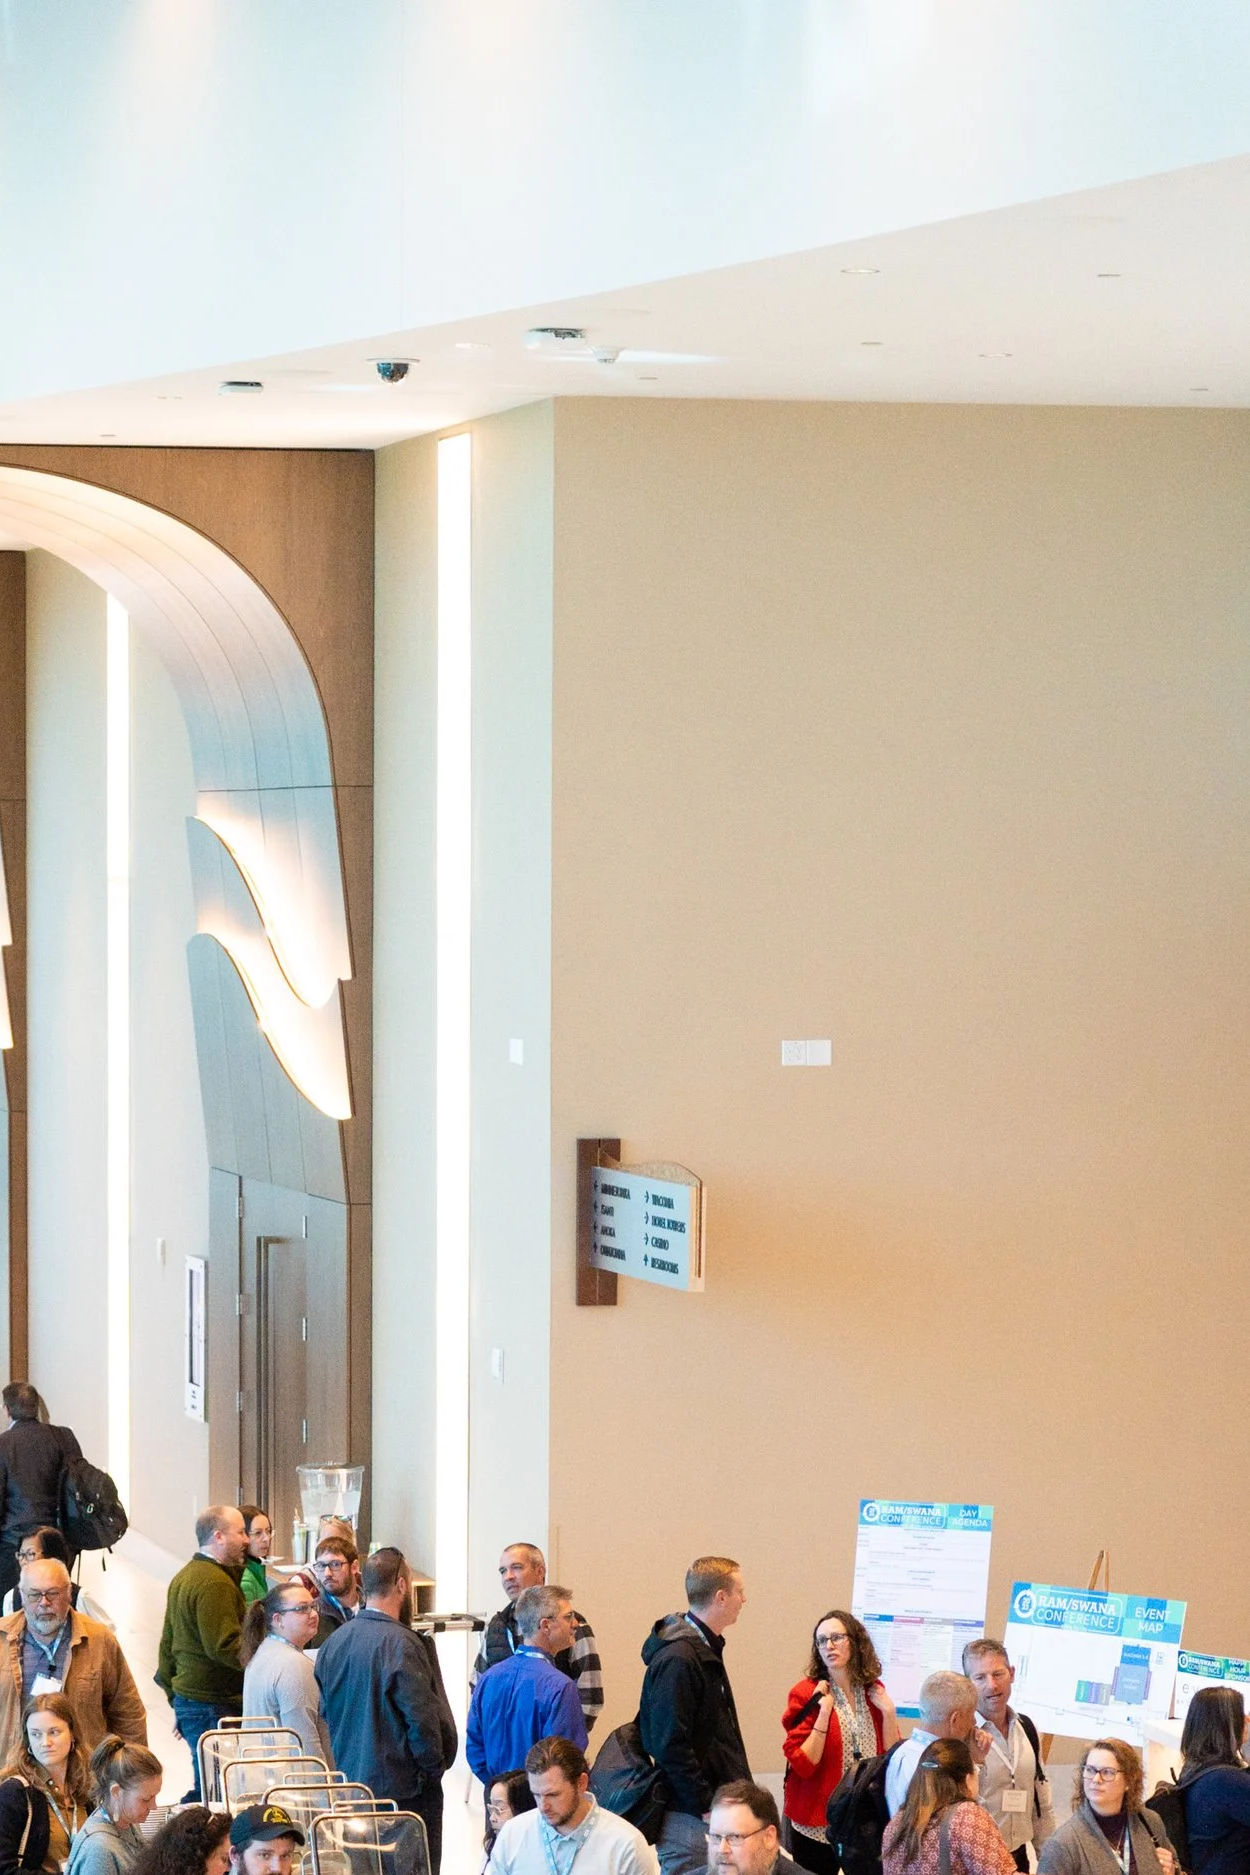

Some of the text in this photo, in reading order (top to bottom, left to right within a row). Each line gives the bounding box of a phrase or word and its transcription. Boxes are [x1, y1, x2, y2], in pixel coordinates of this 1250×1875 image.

[651, 1236, 669, 1251] CASINO
[881, 1505, 942, 1517] RAM/SWANA
[959, 1508, 977, 1518] DAY
[880, 1513, 942, 1526] CONFERENCE
[952, 1517, 988, 1528] AGENDA
[1038, 1595, 1117, 1616] RAM/SWANA
[1036, 1609, 1115, 1630] CONFERENCE
[1135, 1606, 1172, 1621] EVENT
[1138, 1622, 1164, 1634] MAP
